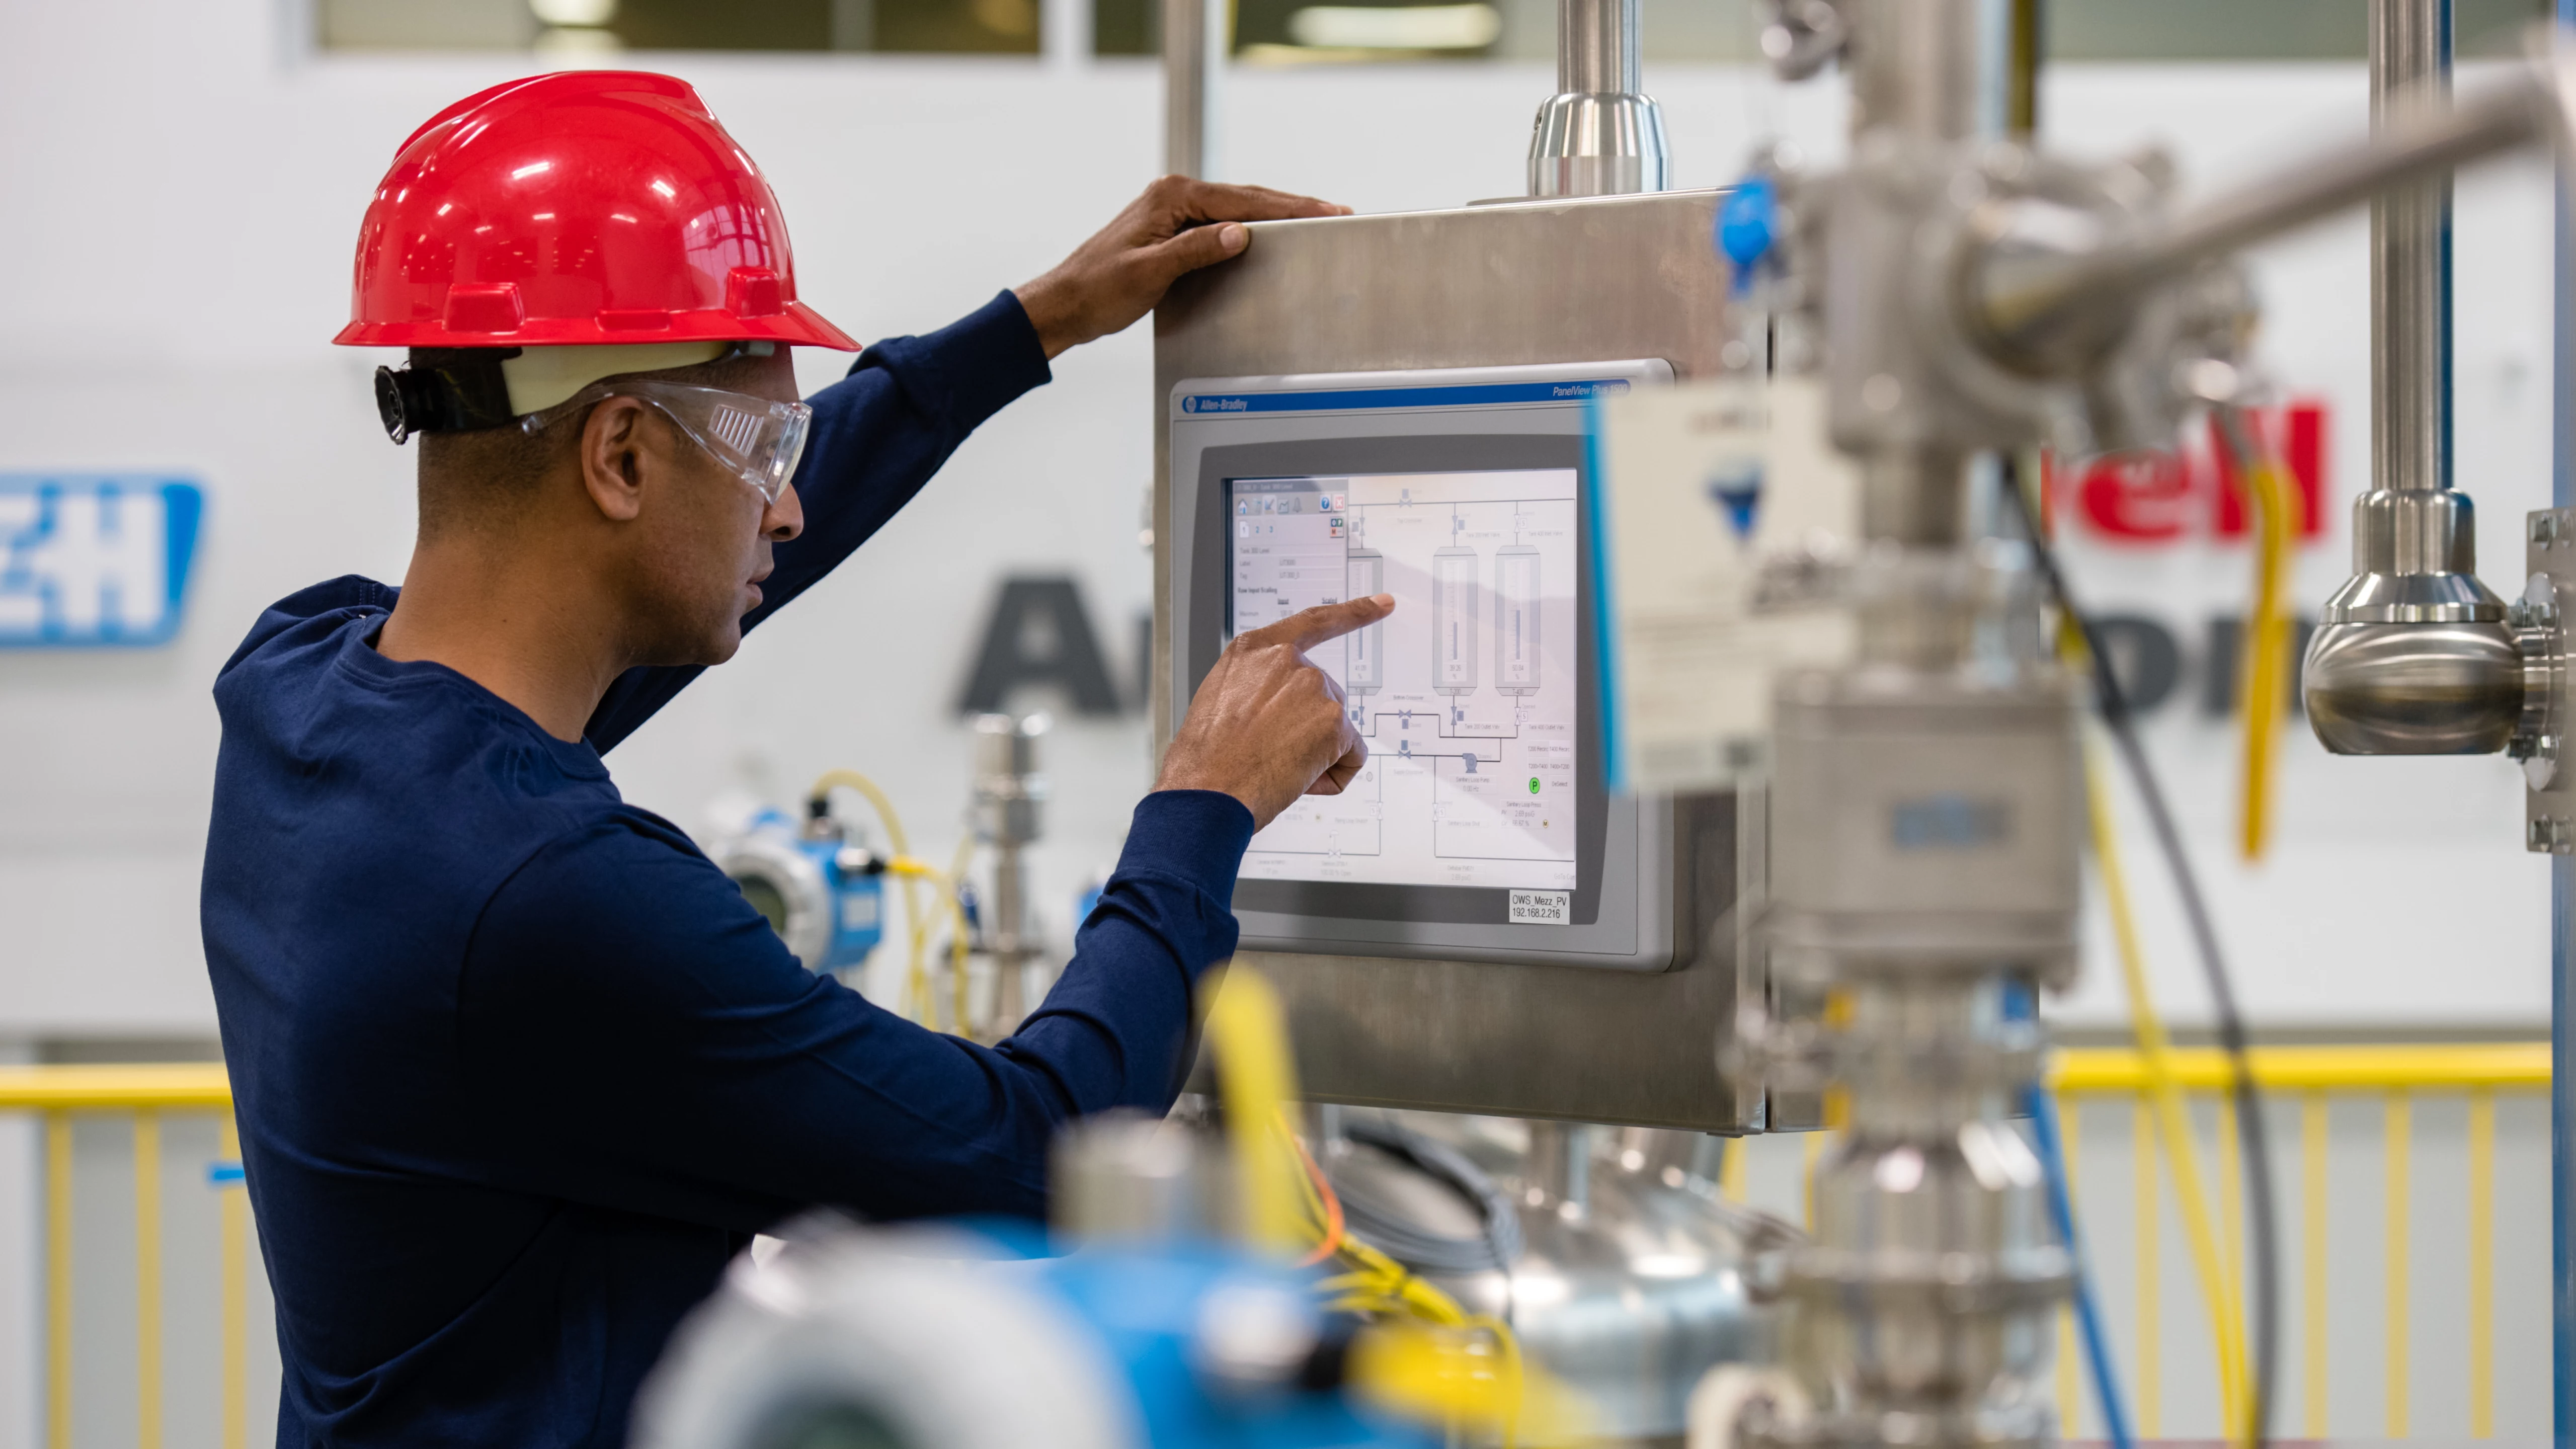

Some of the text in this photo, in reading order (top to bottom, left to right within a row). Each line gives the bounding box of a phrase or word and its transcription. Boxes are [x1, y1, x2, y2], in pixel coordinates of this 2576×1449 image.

[1553, 384, 1627, 396] PanelView Plus 1500
[1200, 398, 1248, 412] Allen-Bradley
[1532, 781, 1538, 790] P
[1512, 895, 1567, 908] OWS_Mezz_PV
[1512, 907, 1560, 919] 192.168.2.216
